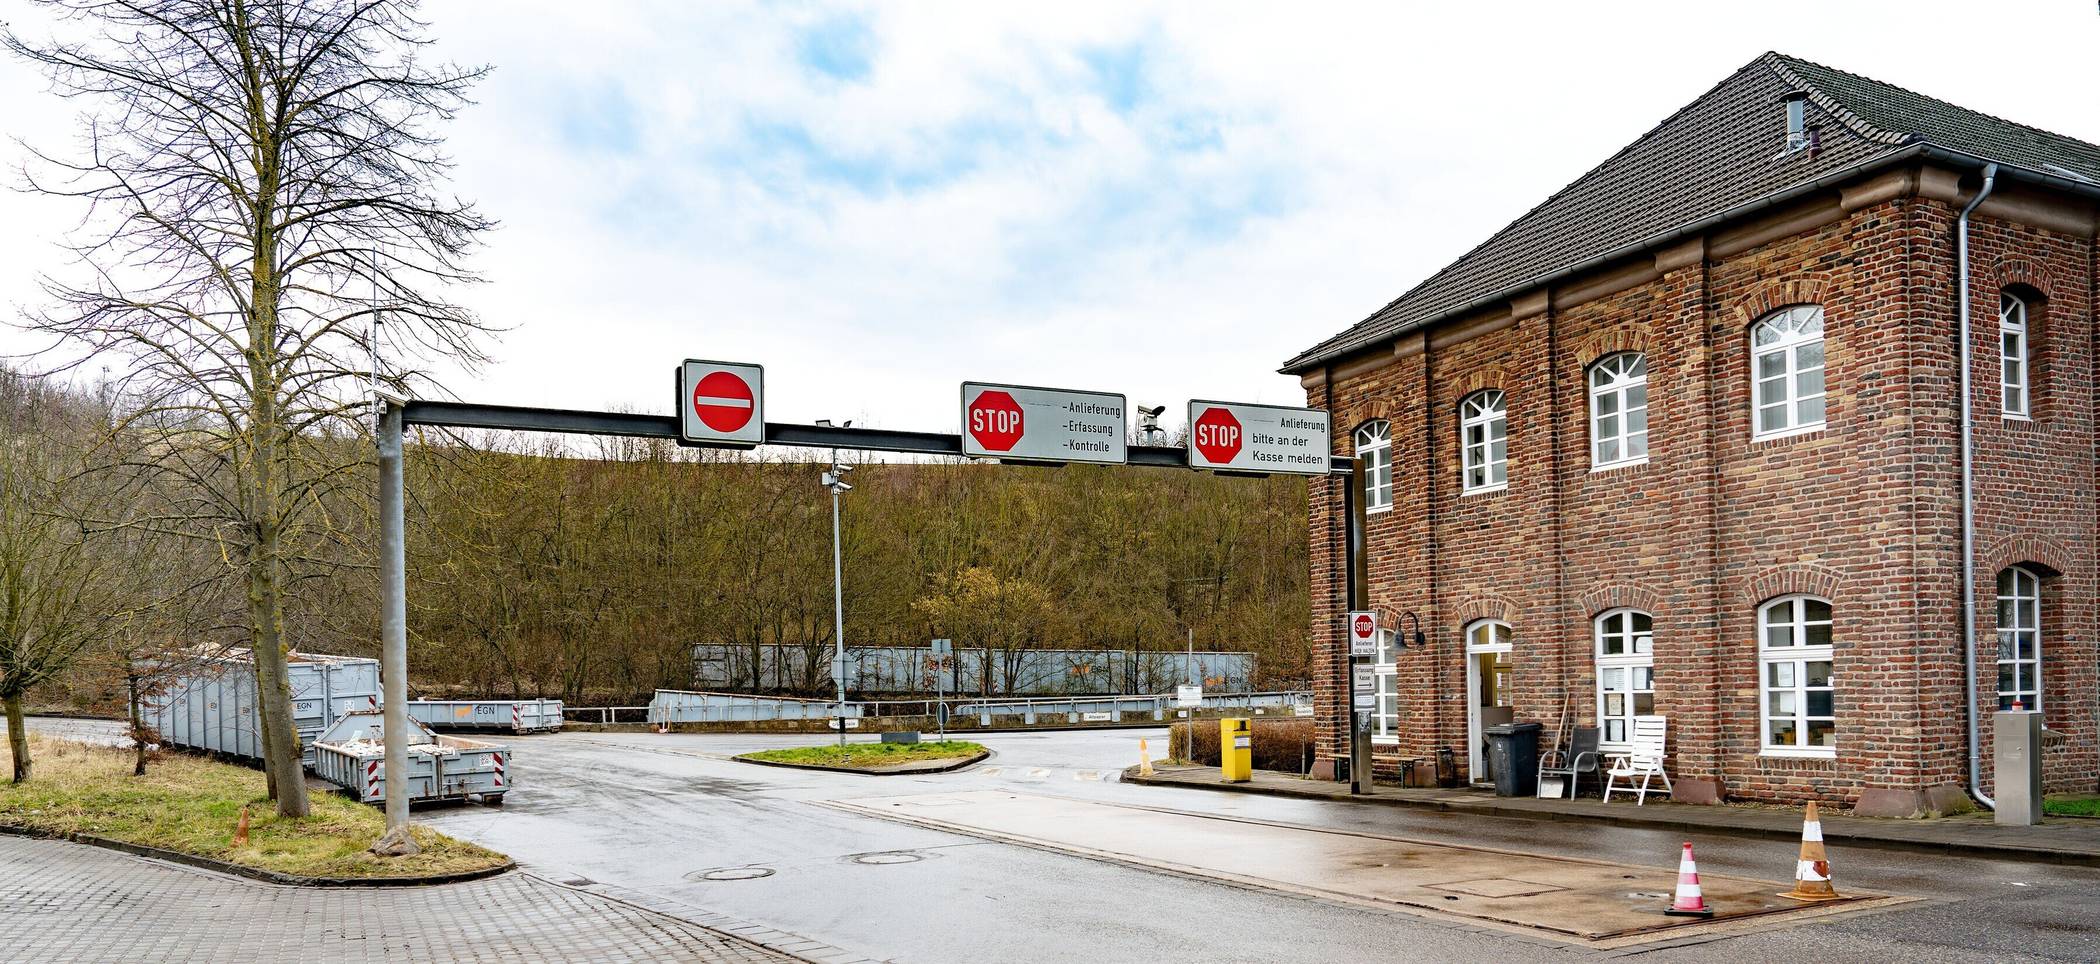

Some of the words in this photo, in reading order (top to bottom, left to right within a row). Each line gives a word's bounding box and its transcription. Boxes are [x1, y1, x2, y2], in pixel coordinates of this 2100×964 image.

[973, 408, 1020, 434] STOP
[1280, 417, 1325, 433] Anlieferung
[1199, 424, 1239, 448] STOP
[1252, 432, 1274, 445] bitte
[1277, 437, 1290, 446] an
[1292, 436, 1309, 447] der
[1252, 450, 1284, 463] Kasse
[1287, 453, 1323, 465] melden
[1355, 621, 1373, 632] STOP
[297, 702, 312, 710] EGN
[477, 705, 495, 715] EGN
